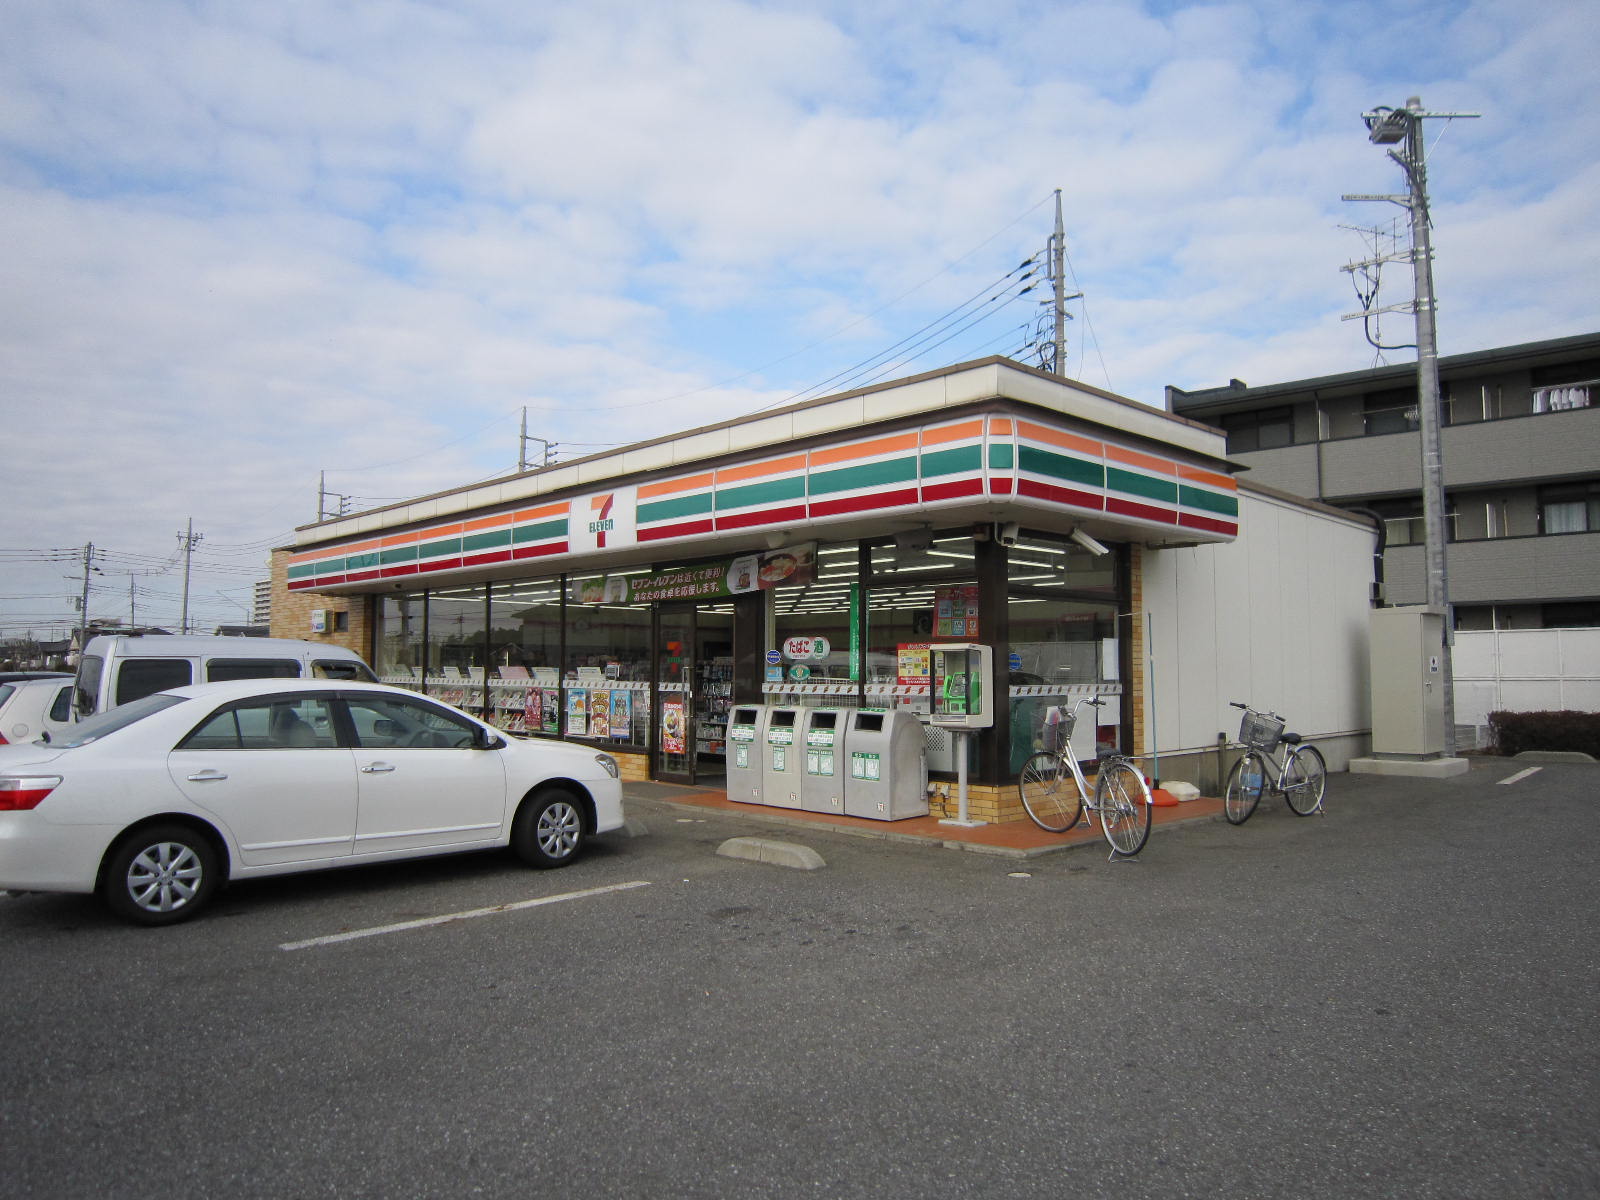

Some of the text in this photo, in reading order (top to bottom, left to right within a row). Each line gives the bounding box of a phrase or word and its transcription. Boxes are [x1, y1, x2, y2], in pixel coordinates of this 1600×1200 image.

[591, 493, 614, 548] 7
[788, 640, 824, 654] たばこ 酒
